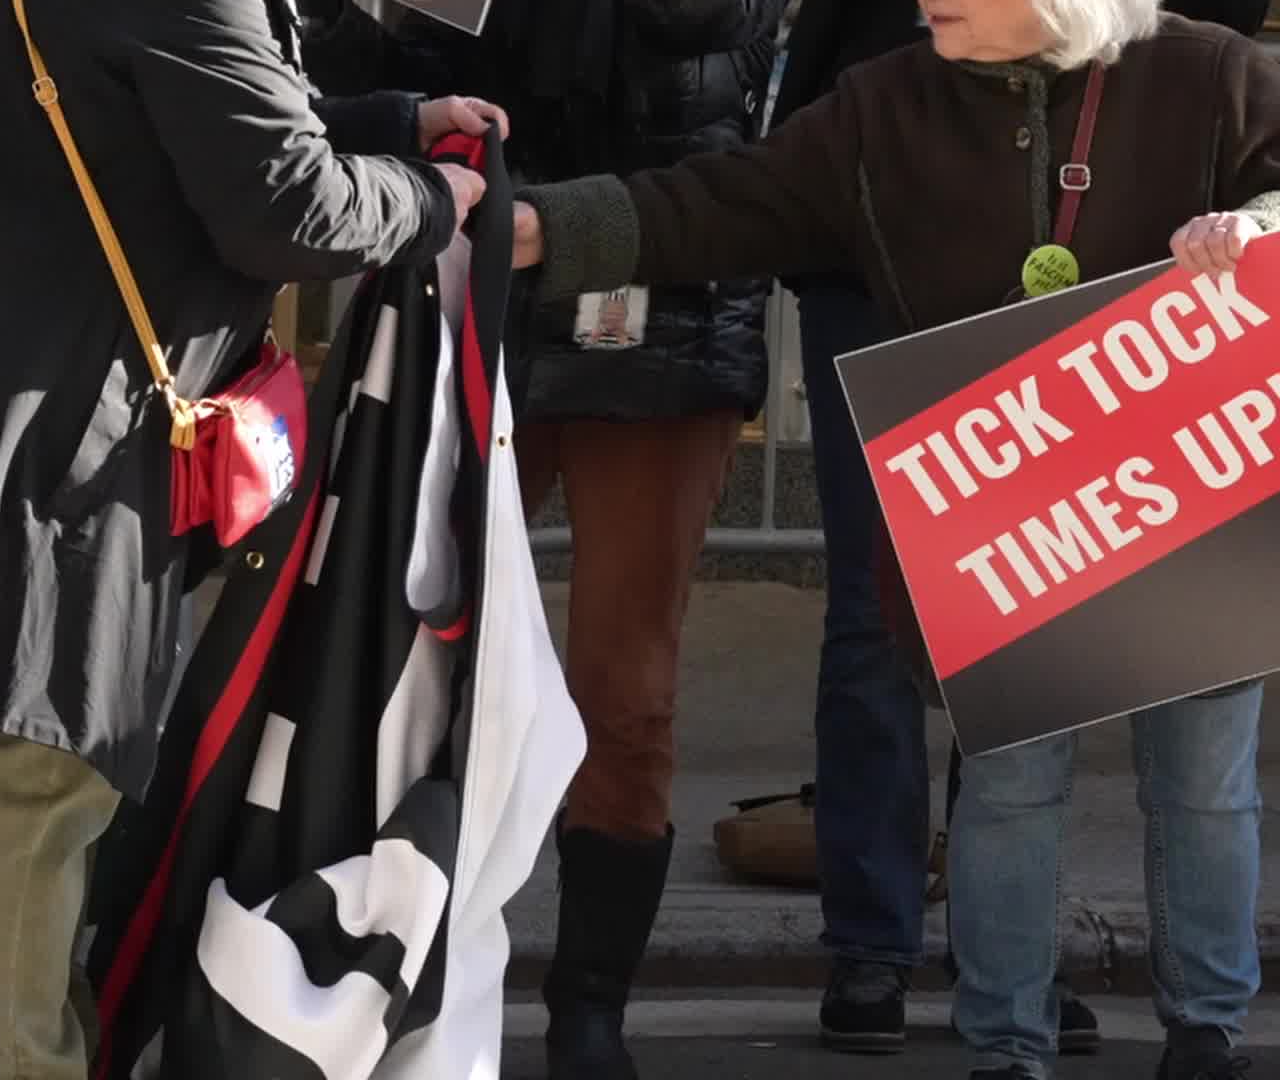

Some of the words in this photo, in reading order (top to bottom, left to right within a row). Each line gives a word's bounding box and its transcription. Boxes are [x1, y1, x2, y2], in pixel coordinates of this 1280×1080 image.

[884, 375, 1074, 517] TICK
[1057, 269, 1270, 415] TOCK
[955, 455, 1180, 617] TIMES
